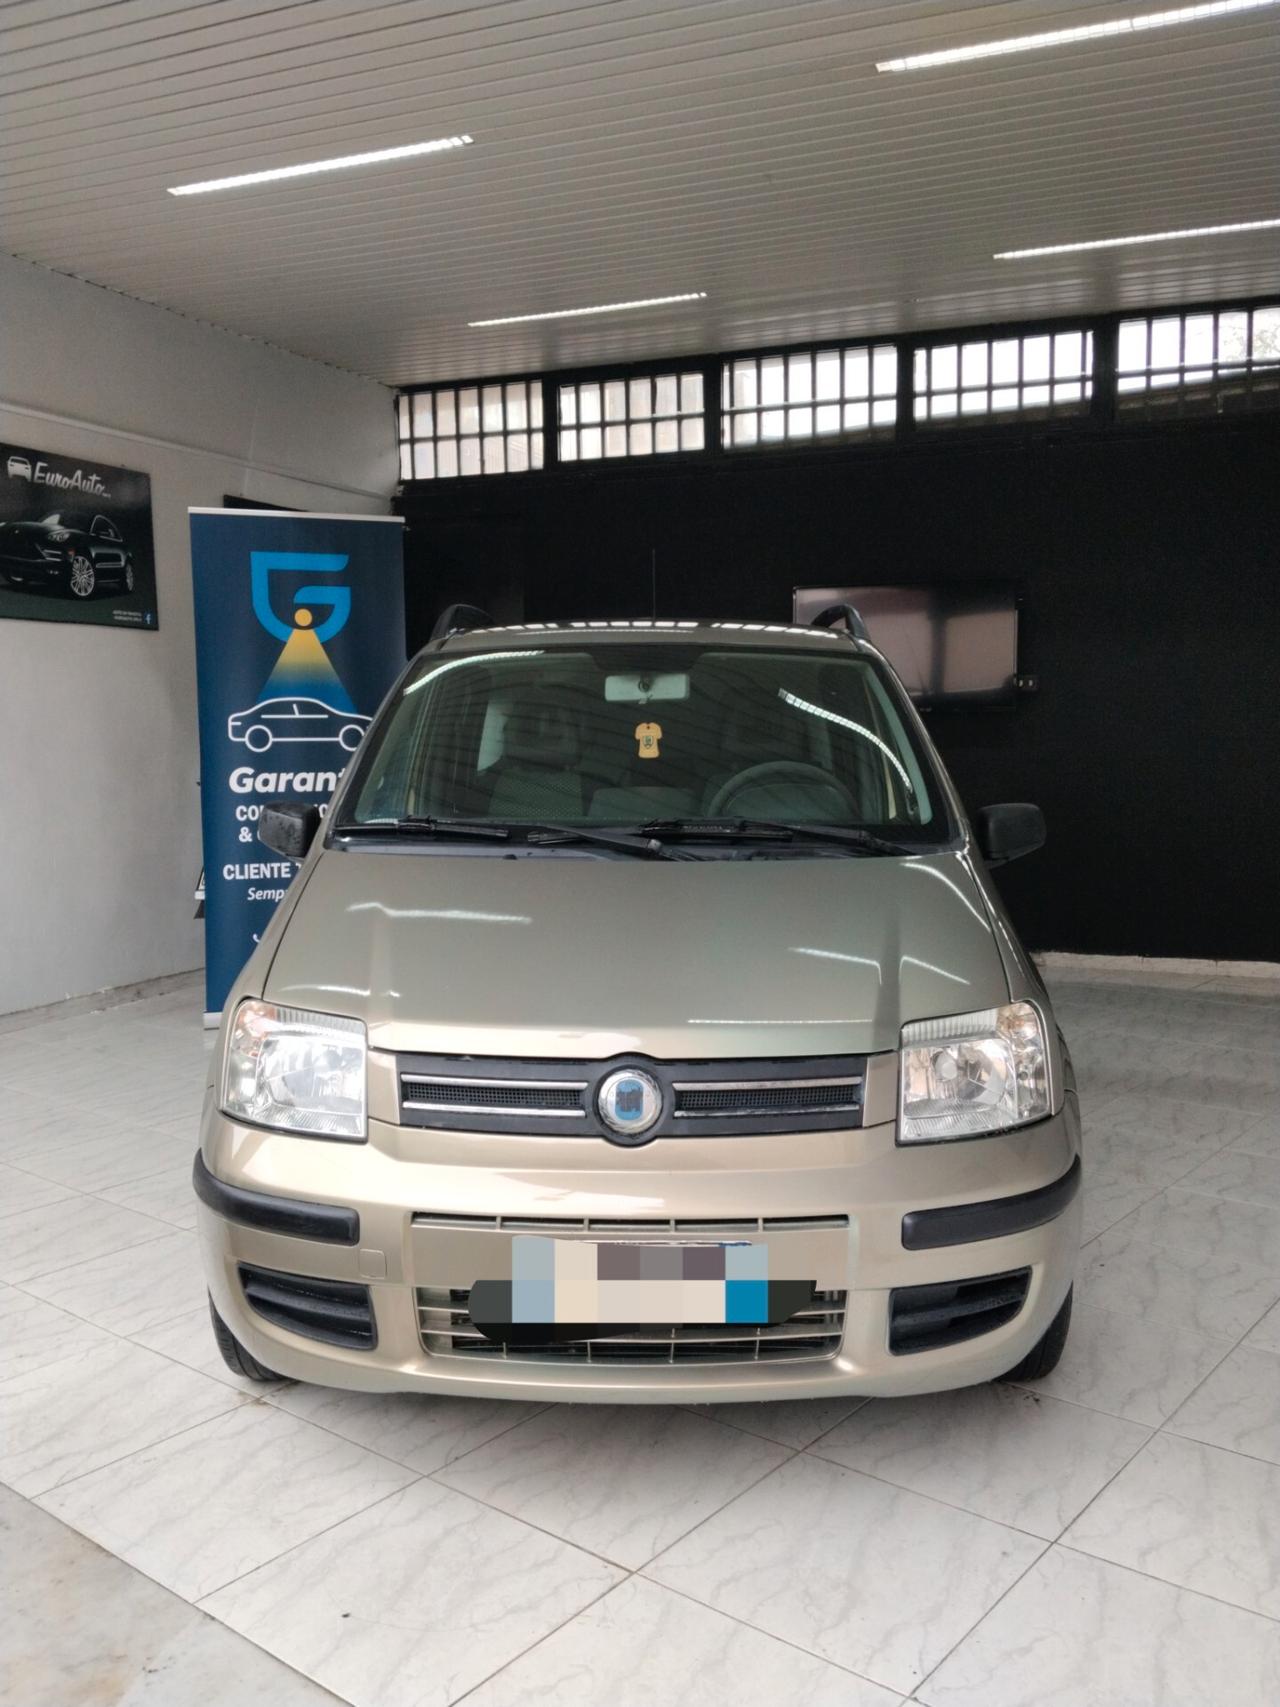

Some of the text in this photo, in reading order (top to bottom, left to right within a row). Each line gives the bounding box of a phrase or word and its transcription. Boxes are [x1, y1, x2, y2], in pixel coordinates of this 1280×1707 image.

[33, 461, 105, 495] EuroAuto
[238, 826, 253, 842] &
[222, 862, 292, 880] CLIENTE
[247, 887, 288, 902] Semp
